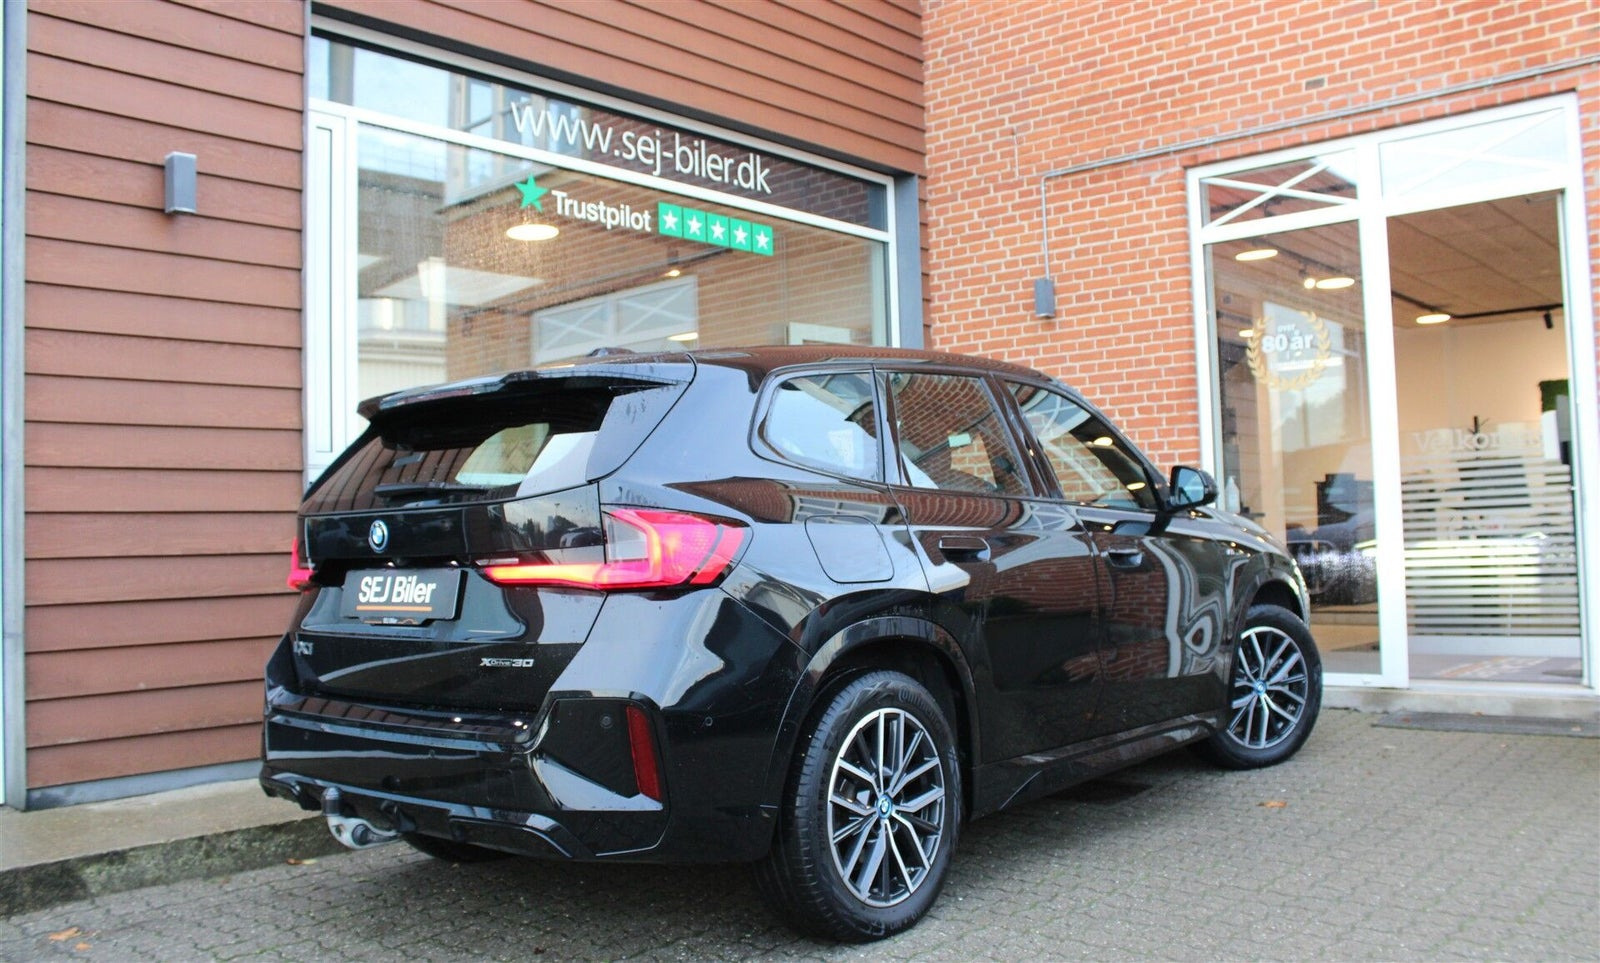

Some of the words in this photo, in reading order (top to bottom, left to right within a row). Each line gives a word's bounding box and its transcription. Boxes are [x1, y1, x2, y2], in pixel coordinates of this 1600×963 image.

[510, 102, 772, 194] www.sej-biler.dk
[551, 190, 651, 232] Trustpilot
[358, 575, 391, 603] SEJ
[391, 575, 437, 604] Biler
